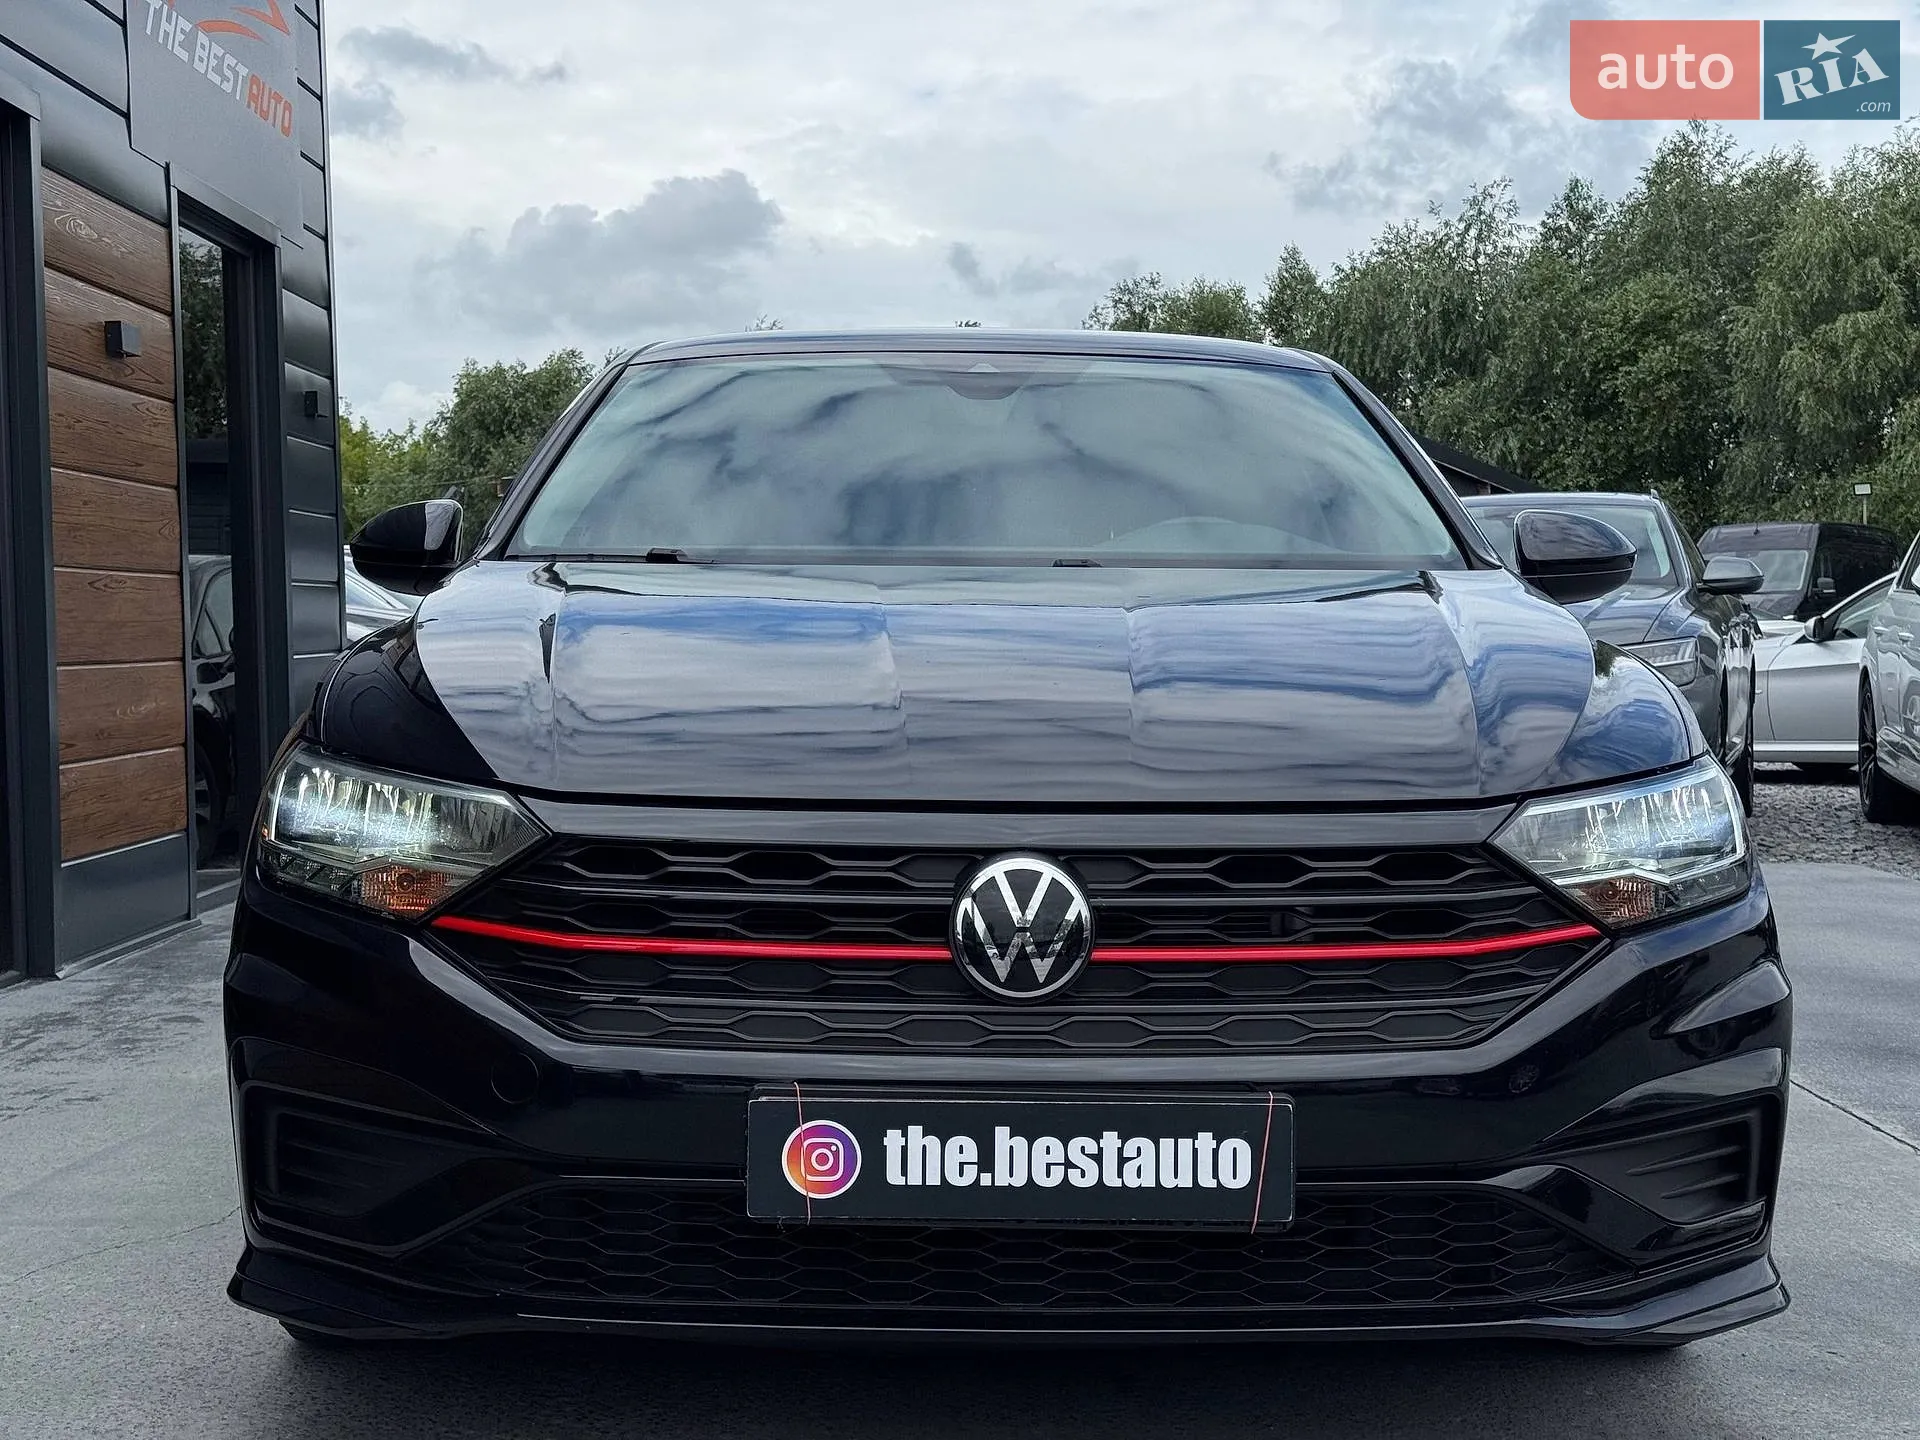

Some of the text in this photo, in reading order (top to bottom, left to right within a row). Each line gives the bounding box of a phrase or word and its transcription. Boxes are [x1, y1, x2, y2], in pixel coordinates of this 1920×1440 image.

[146, 0, 292, 137] THE BEST AUTO
[884, 1126, 1252, 1188] the.bestauto
